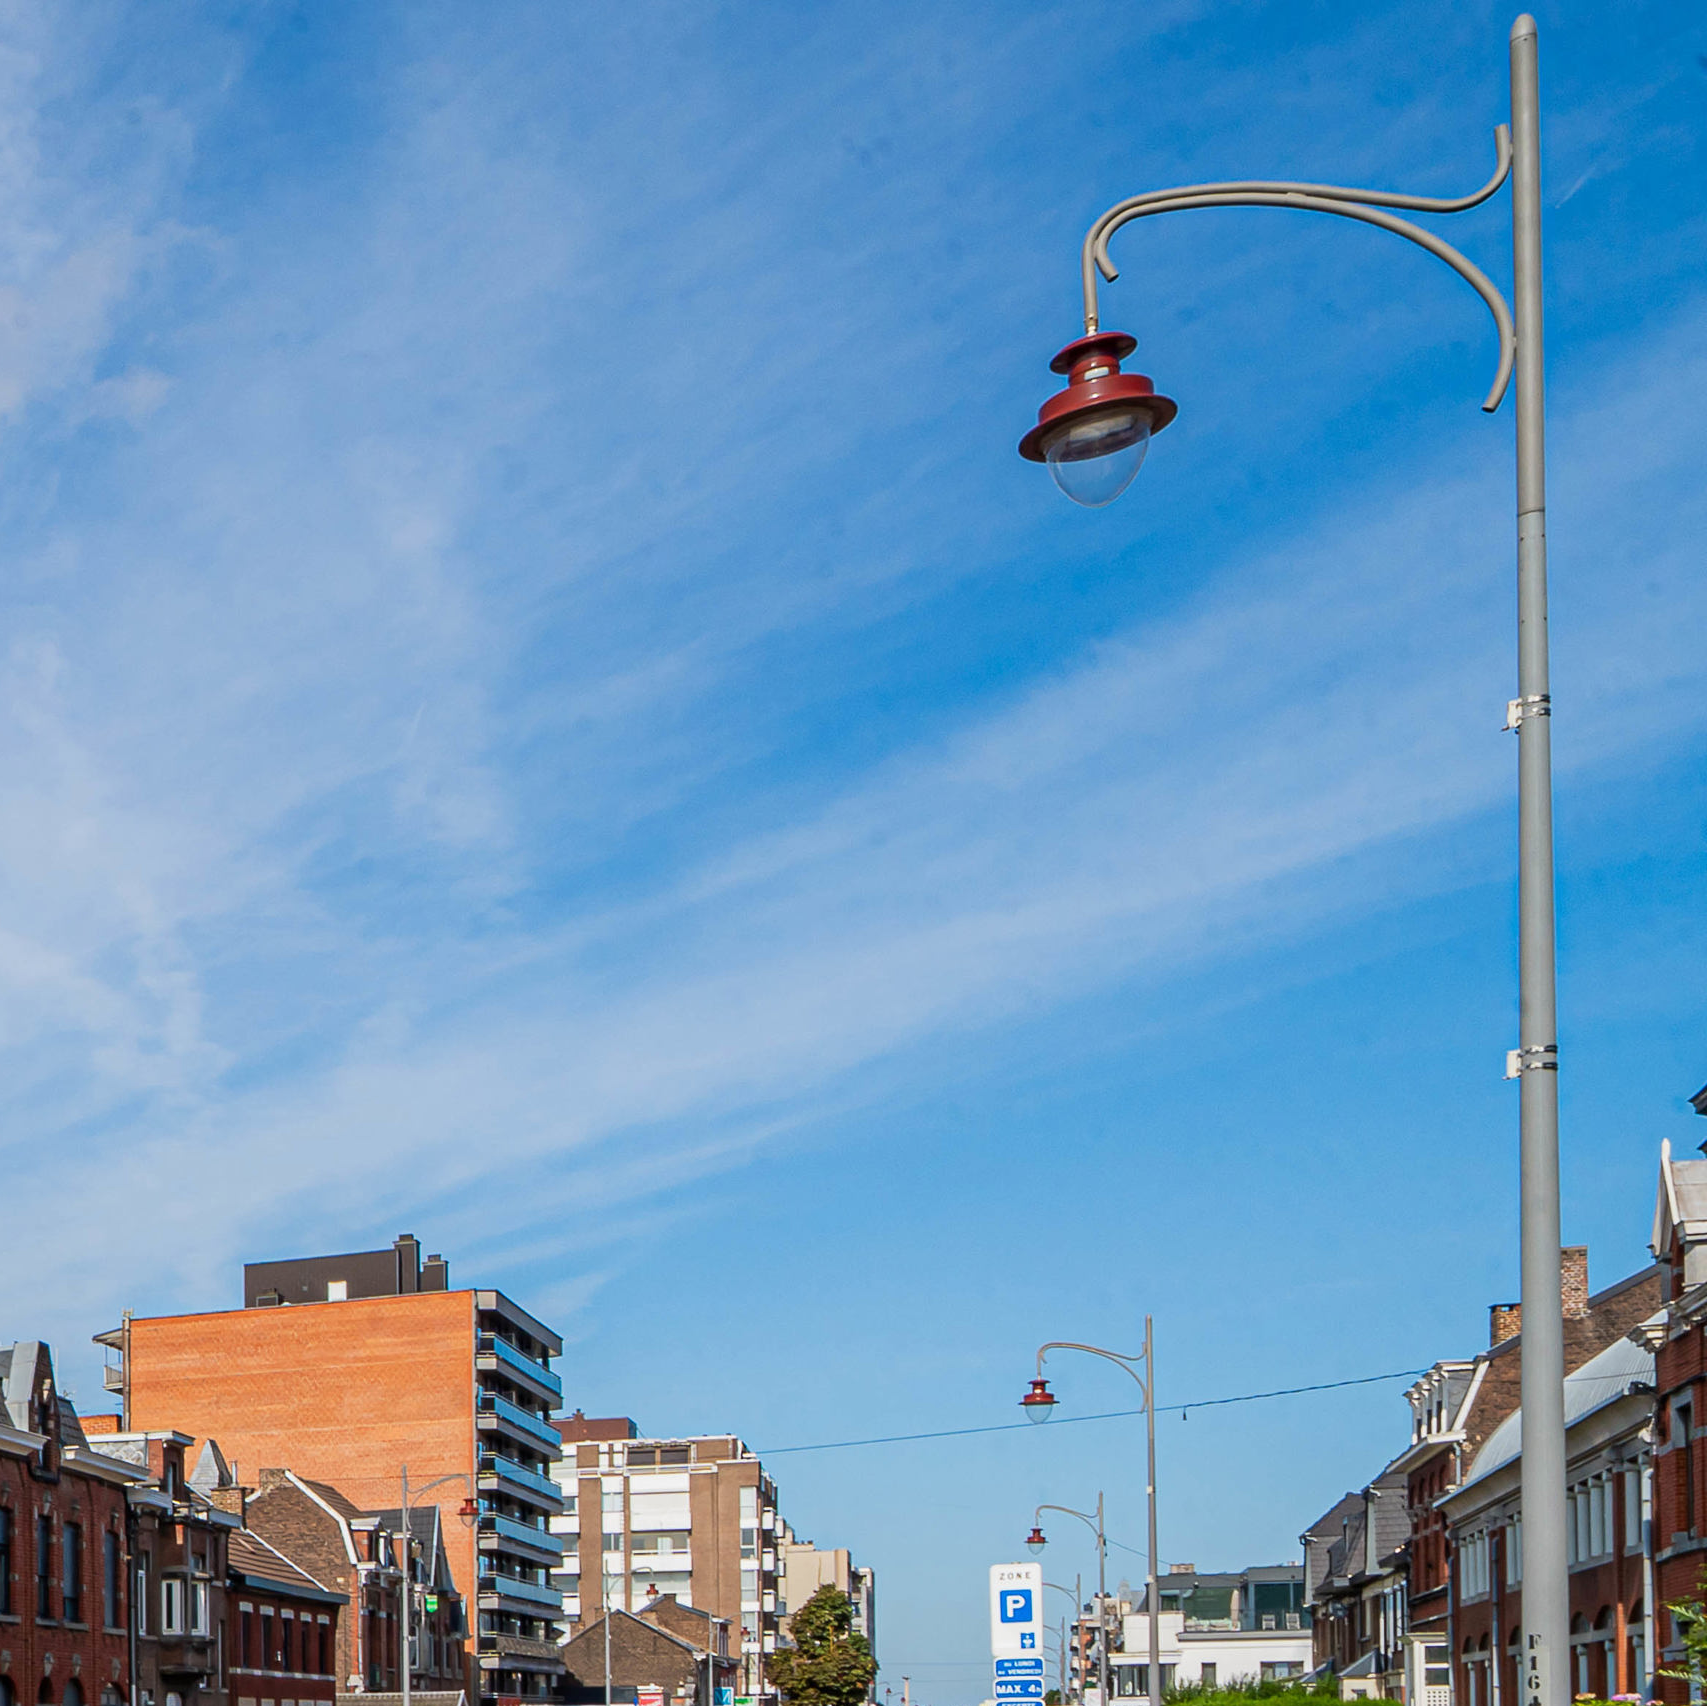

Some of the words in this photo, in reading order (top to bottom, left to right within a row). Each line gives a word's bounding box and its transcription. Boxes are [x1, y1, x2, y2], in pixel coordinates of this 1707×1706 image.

[999, 1571, 1032, 1581] ZONE
[1006, 1594, 1026, 1618] P
[996, 1685, 1025, 1694] MAX.
